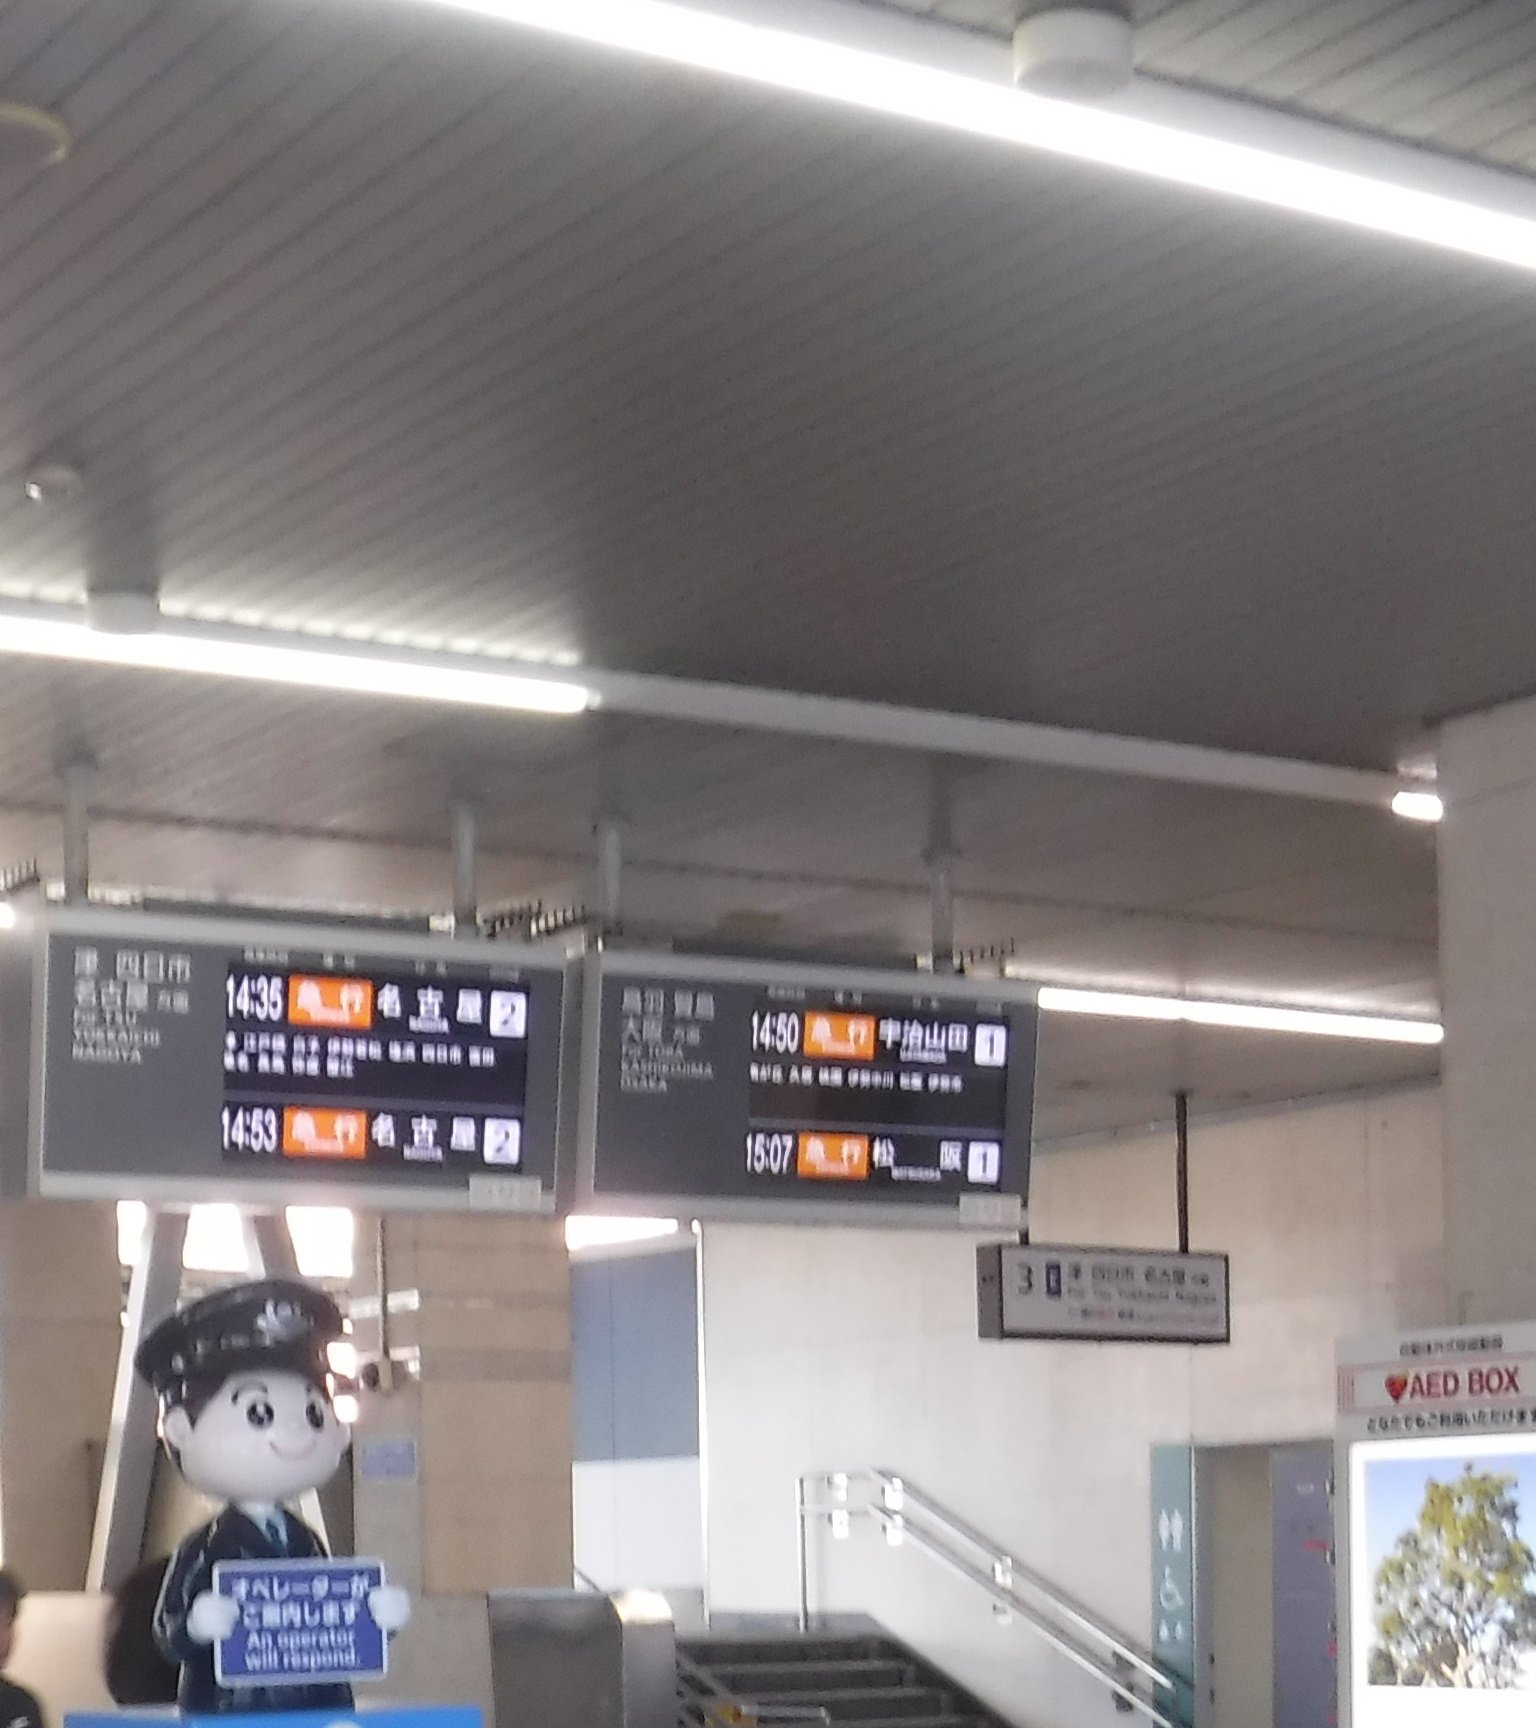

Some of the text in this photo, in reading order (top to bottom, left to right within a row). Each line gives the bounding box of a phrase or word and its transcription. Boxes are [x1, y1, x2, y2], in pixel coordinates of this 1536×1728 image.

[116, 949, 191, 983] 四日市
[74, 977, 149, 1012] 名古屋
[226, 973, 283, 1022] 14:35
[296, 979, 366, 1018] 急行
[377, 983, 483, 1025] 名古屋
[751, 1009, 800, 1054] 14:50
[810, 1017, 867, 1049] 急行
[879, 1018, 968, 1052] 宇治山田
[221, 1105, 279, 1153] 14:53
[291, 1111, 360, 1150] 急行
[372, 1112, 476, 1152] 名古屋
[745, 1132, 793, 1175] 15:07
[804, 1138, 862, 1170] 急行
[1410, 1366, 1521, 1401] AED BOX
